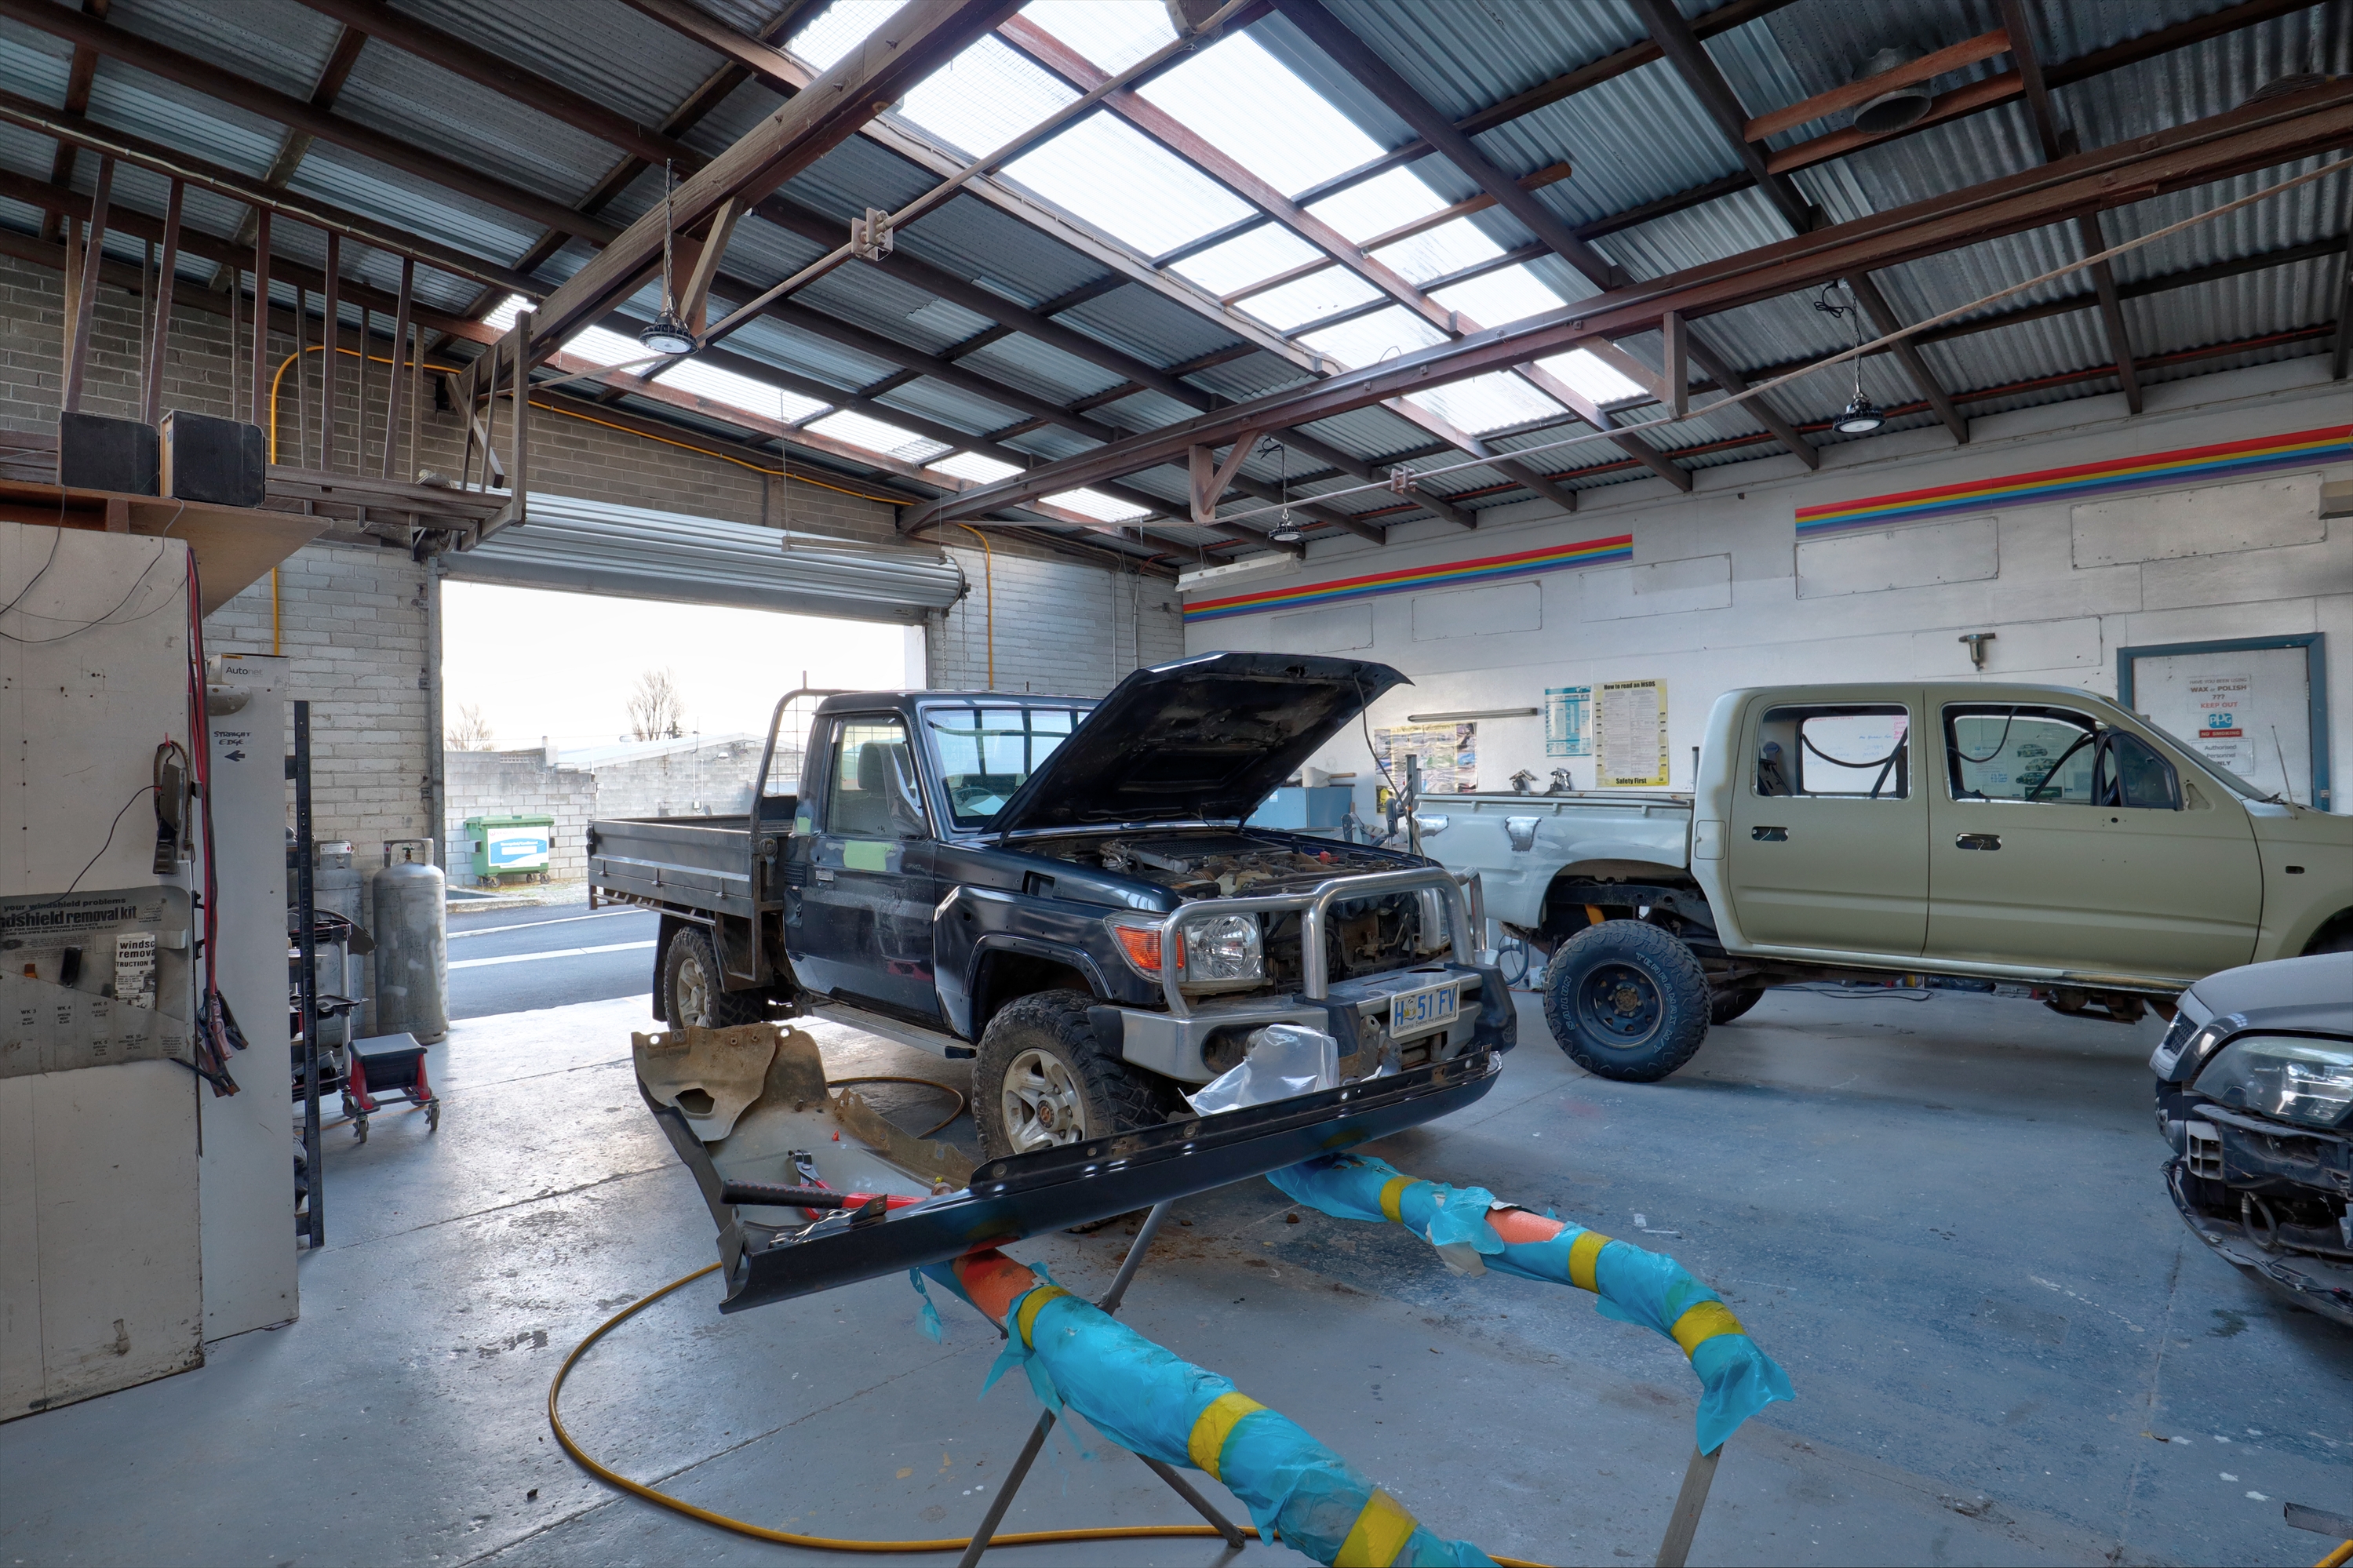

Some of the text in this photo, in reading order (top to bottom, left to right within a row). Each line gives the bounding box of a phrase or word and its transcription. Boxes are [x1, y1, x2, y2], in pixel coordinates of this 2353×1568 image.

[225, 667, 263, 675] Autonet
[2209, 714, 2231, 726] PPG
[29, 900, 81, 910] windshield
[83, 898, 126, 908] problems
[67, 907, 119, 924] removal
[121, 905, 137, 920] kit
[1635, 951, 1677, 1026] TERRAMAX
[1394, 988, 1455, 1027] H 51 FV
[1561, 975, 1575, 1030] SAILUN
[1652, 1028, 1673, 1053] M/T
